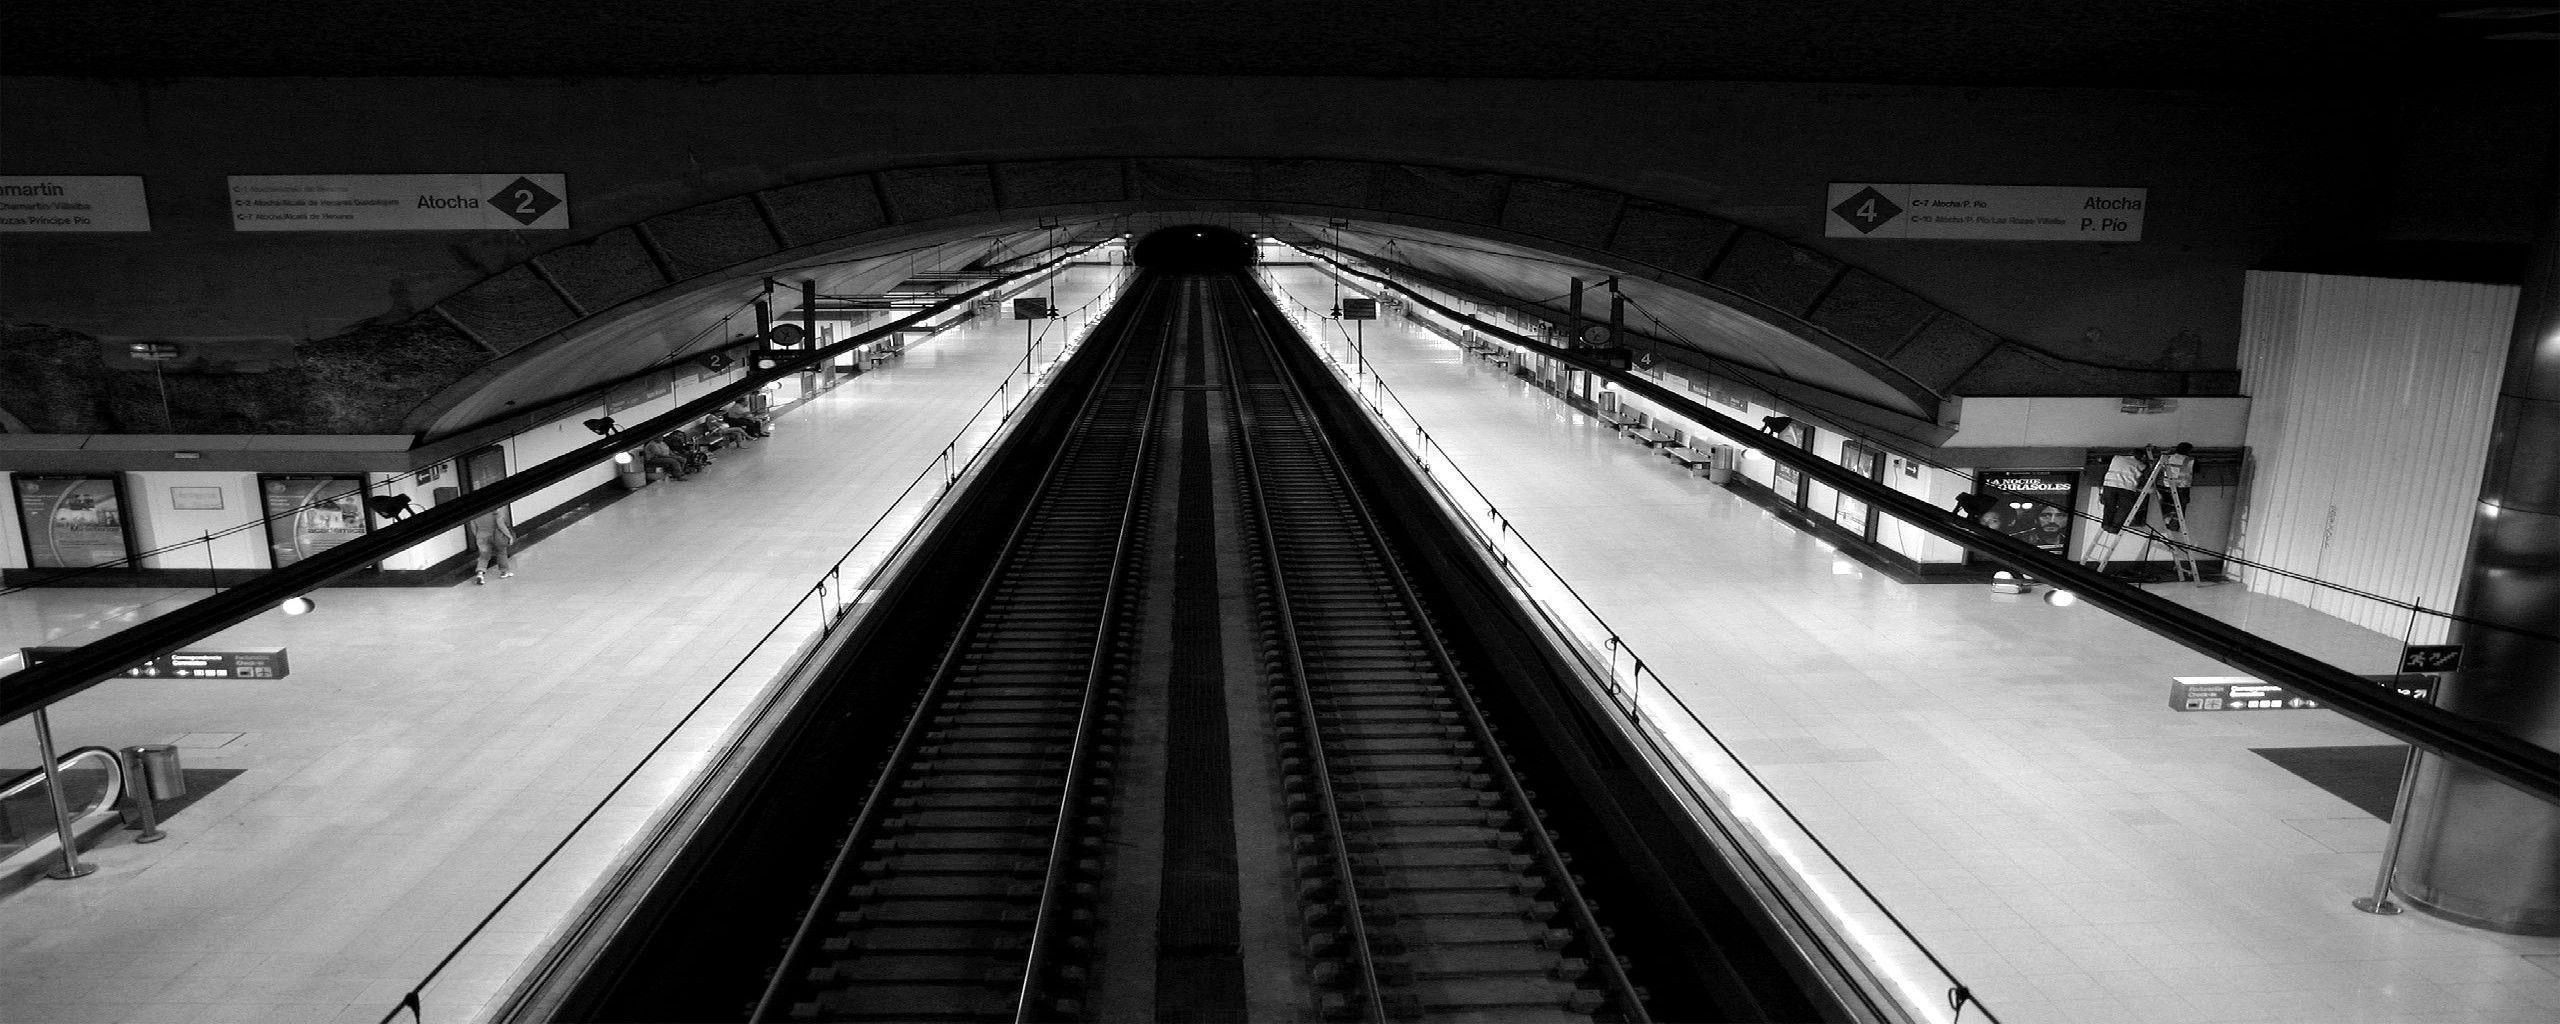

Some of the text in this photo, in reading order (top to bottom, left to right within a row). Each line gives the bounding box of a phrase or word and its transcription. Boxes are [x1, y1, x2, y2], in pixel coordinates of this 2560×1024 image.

[417, 189, 536, 214] Atocha 2
[2083, 197, 2142, 210] Atocha
[1856, 198, 1878, 223] 4
[2081, 217, 2127, 231] P. Pío
[710, 355, 720, 366] 2
[1641, 353, 1651, 364] 4
